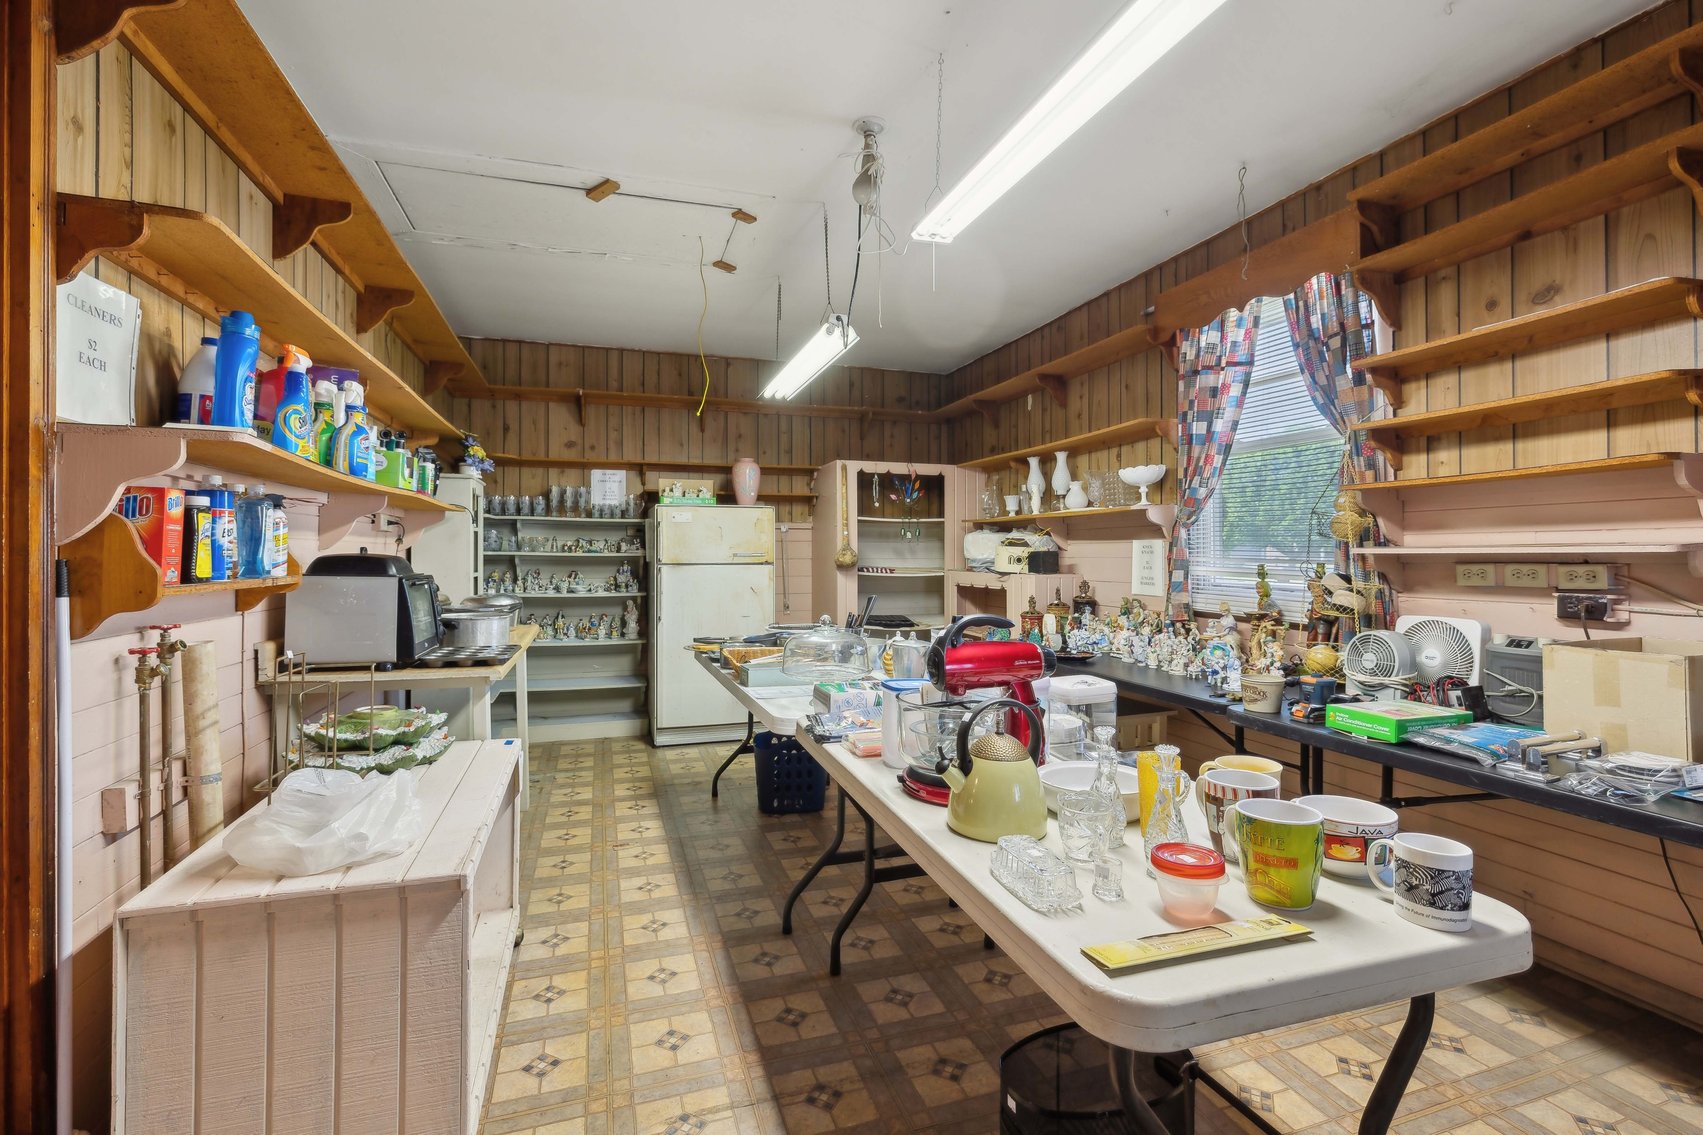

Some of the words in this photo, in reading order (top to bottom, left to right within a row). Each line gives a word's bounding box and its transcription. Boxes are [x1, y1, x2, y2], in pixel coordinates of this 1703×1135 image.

[67, 293, 124, 328] CLEANERS
[79, 351, 107, 372] EACH
[113, 494, 153, 520] illo
[1343, 716, 1373, 728] Conditioner
[1373, 723, 1391, 732] Cover
[1411, 908, 1425, 917] Future
